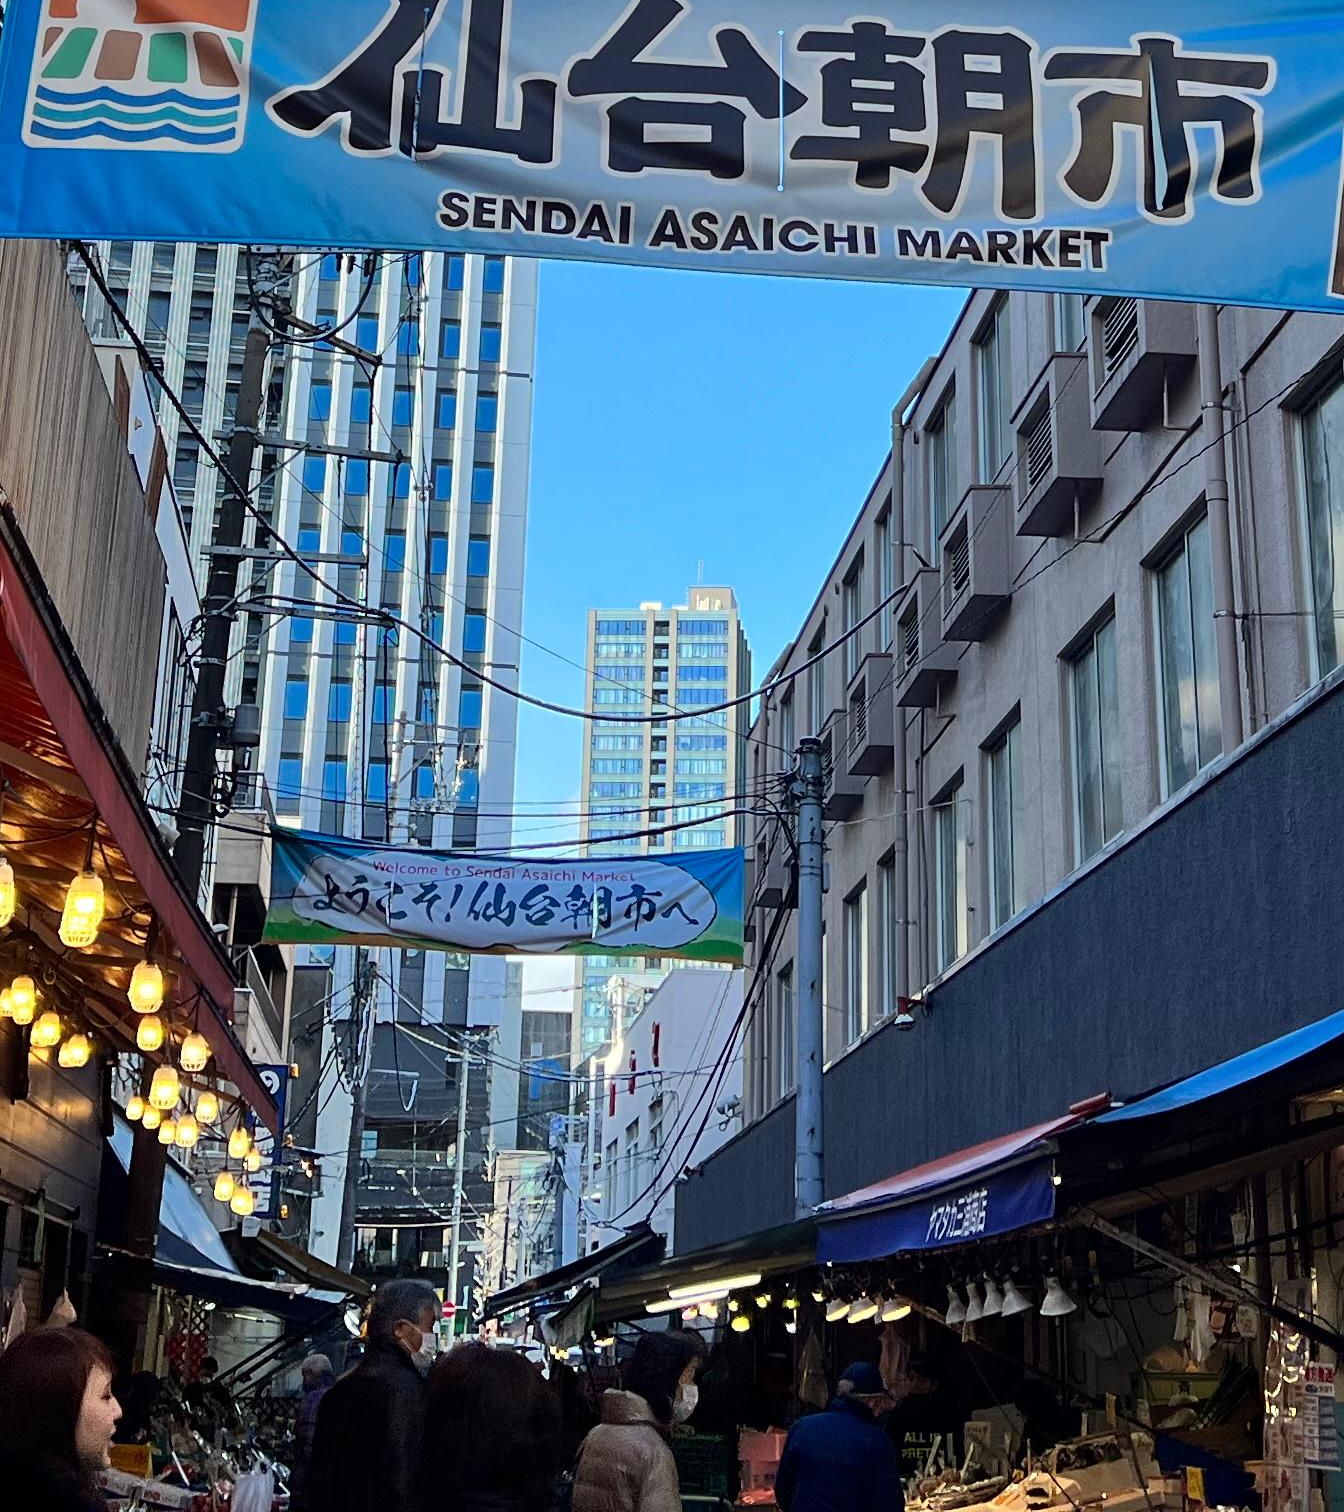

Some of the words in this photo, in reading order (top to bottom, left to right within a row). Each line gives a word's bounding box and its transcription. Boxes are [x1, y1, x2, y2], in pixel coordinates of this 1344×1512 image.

[440, 192, 632, 245] SENDAI
[653, 208, 876, 257] ASAICHI
[897, 228, 1111, 270] MARKET
[373, 860, 438, 876] Welcome
[444, 865, 460, 877] to
[466, 865, 515, 879] Sendai
[521, 867, 576, 881] Asaichi
[582, 869, 636, 883] Market
